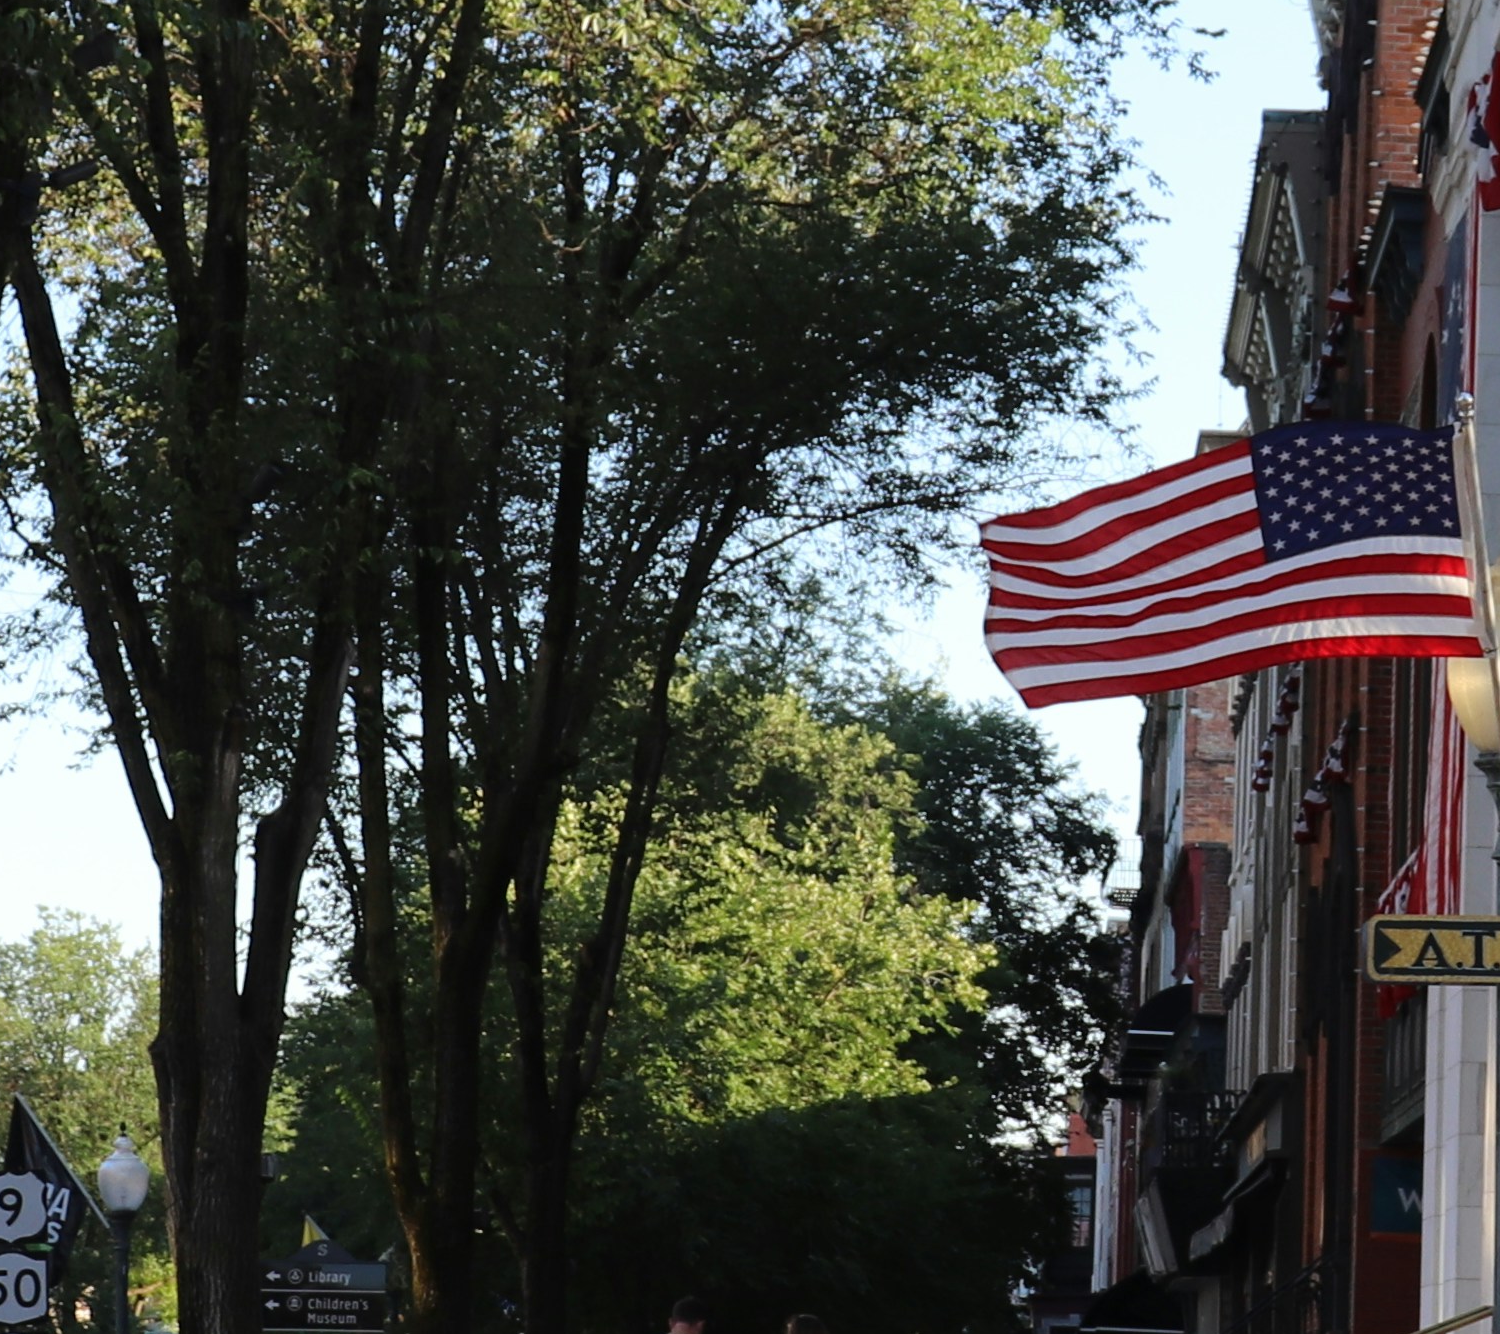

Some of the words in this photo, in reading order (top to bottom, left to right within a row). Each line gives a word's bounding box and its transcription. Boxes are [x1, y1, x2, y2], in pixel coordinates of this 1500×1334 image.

[308, 1271, 351, 1286] Library
[307, 1298, 369, 1310] Children's
[307, 1313, 357, 1324] Museum
